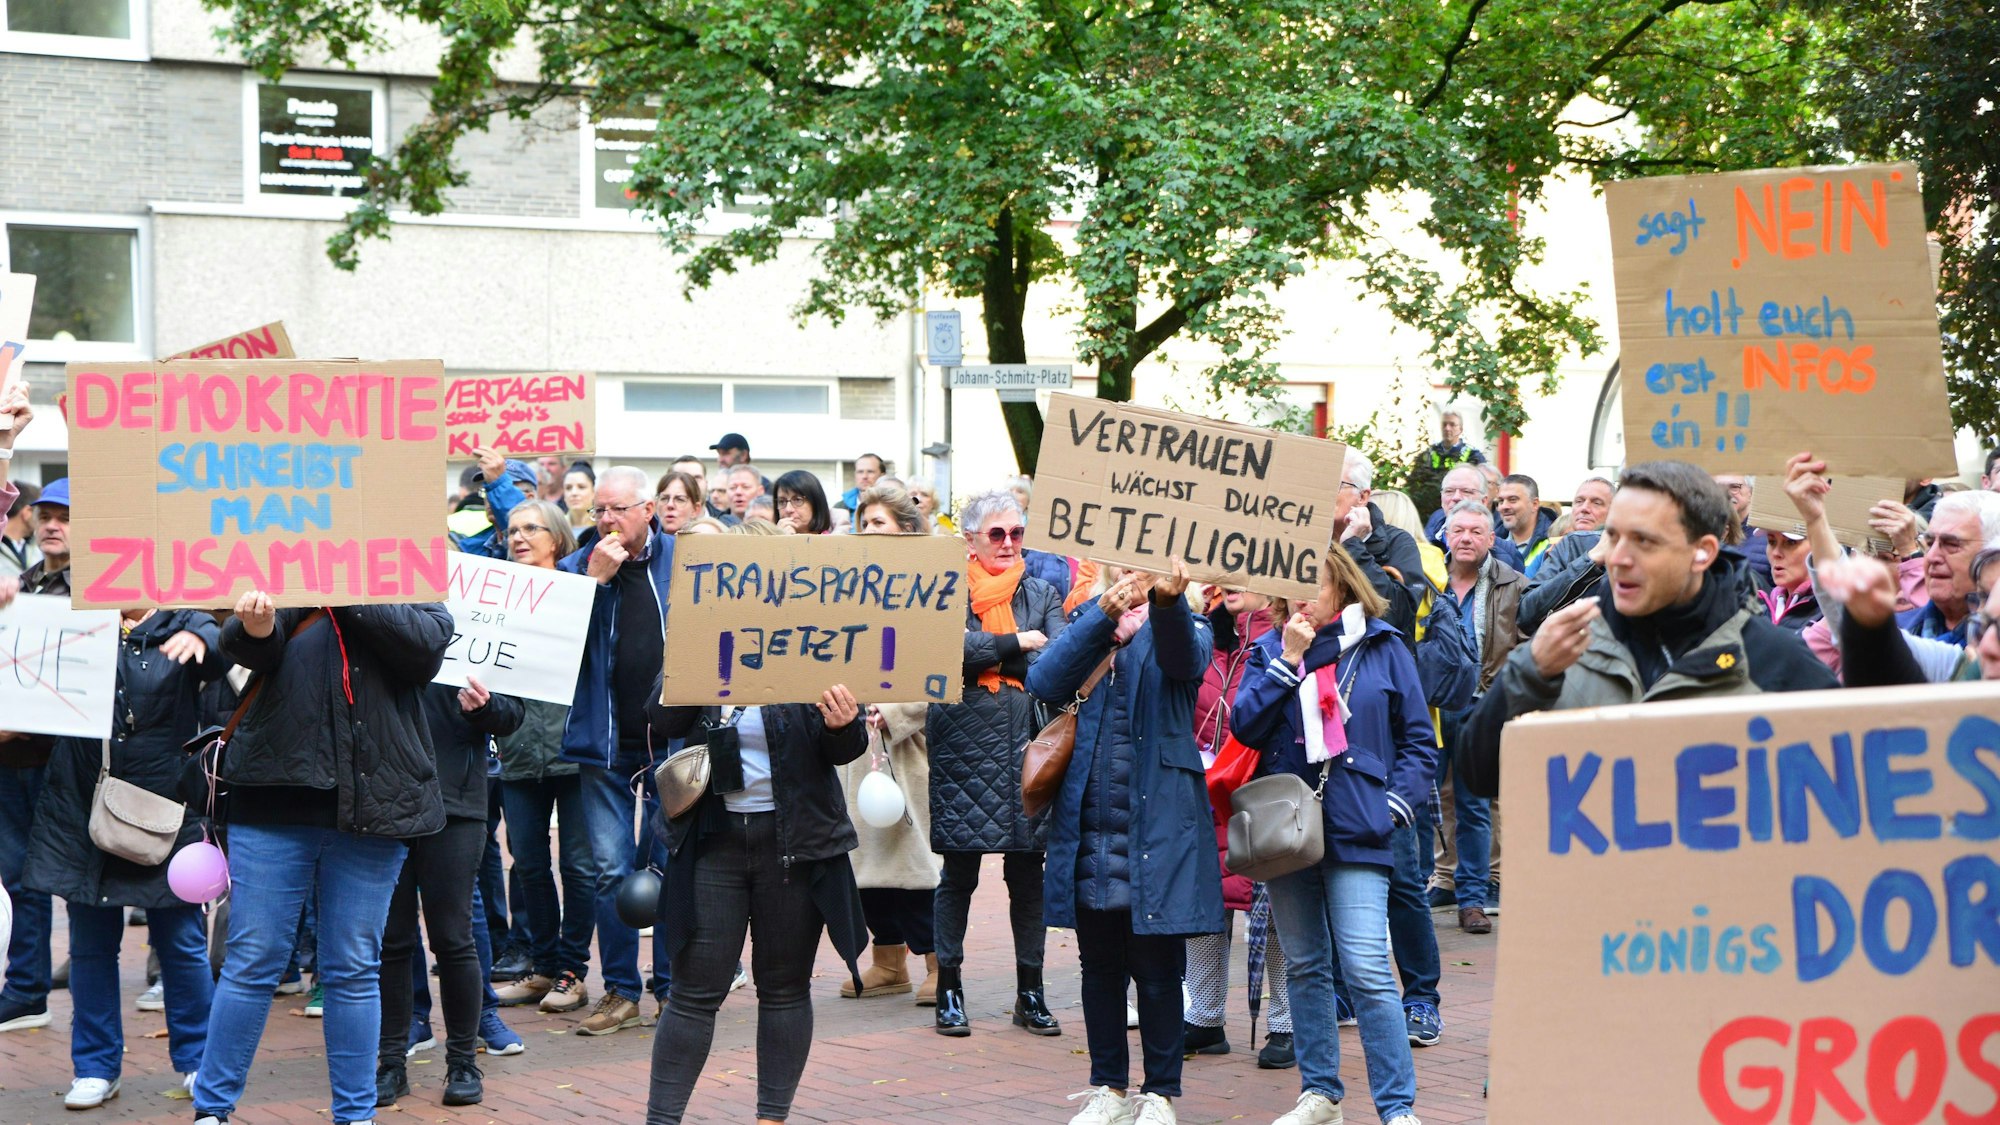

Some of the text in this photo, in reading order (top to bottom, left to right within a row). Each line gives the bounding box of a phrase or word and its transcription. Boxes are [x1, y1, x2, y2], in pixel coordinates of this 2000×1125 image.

[1635, 197, 1706, 256] sagt
[1665, 286, 1855, 342] holt euch
[954, 369, 1068, 386] Johann-Schmitz-Platz
[1645, 339, 1878, 395] erst INFOS
[75, 372, 440, 442] DEMOKRATIE
[156, 441, 363, 493] SCHREIBT
[1069, 408, 1273, 480] VERTRAUEN
[210, 493, 333, 535] MAN
[1111, 470, 1314, 527] WÄCHST DURCH
[1048, 497, 1317, 584] BETEILIGUNG
[84, 536, 449, 603] ZUSAMMEN
[449, 563, 554, 614] NEIN
[685, 562, 960, 611] TRANSPARENZ
[471, 611, 506, 627] ZUR
[0, 624, 96, 695] UE
[444, 632, 517, 669] ZUE
